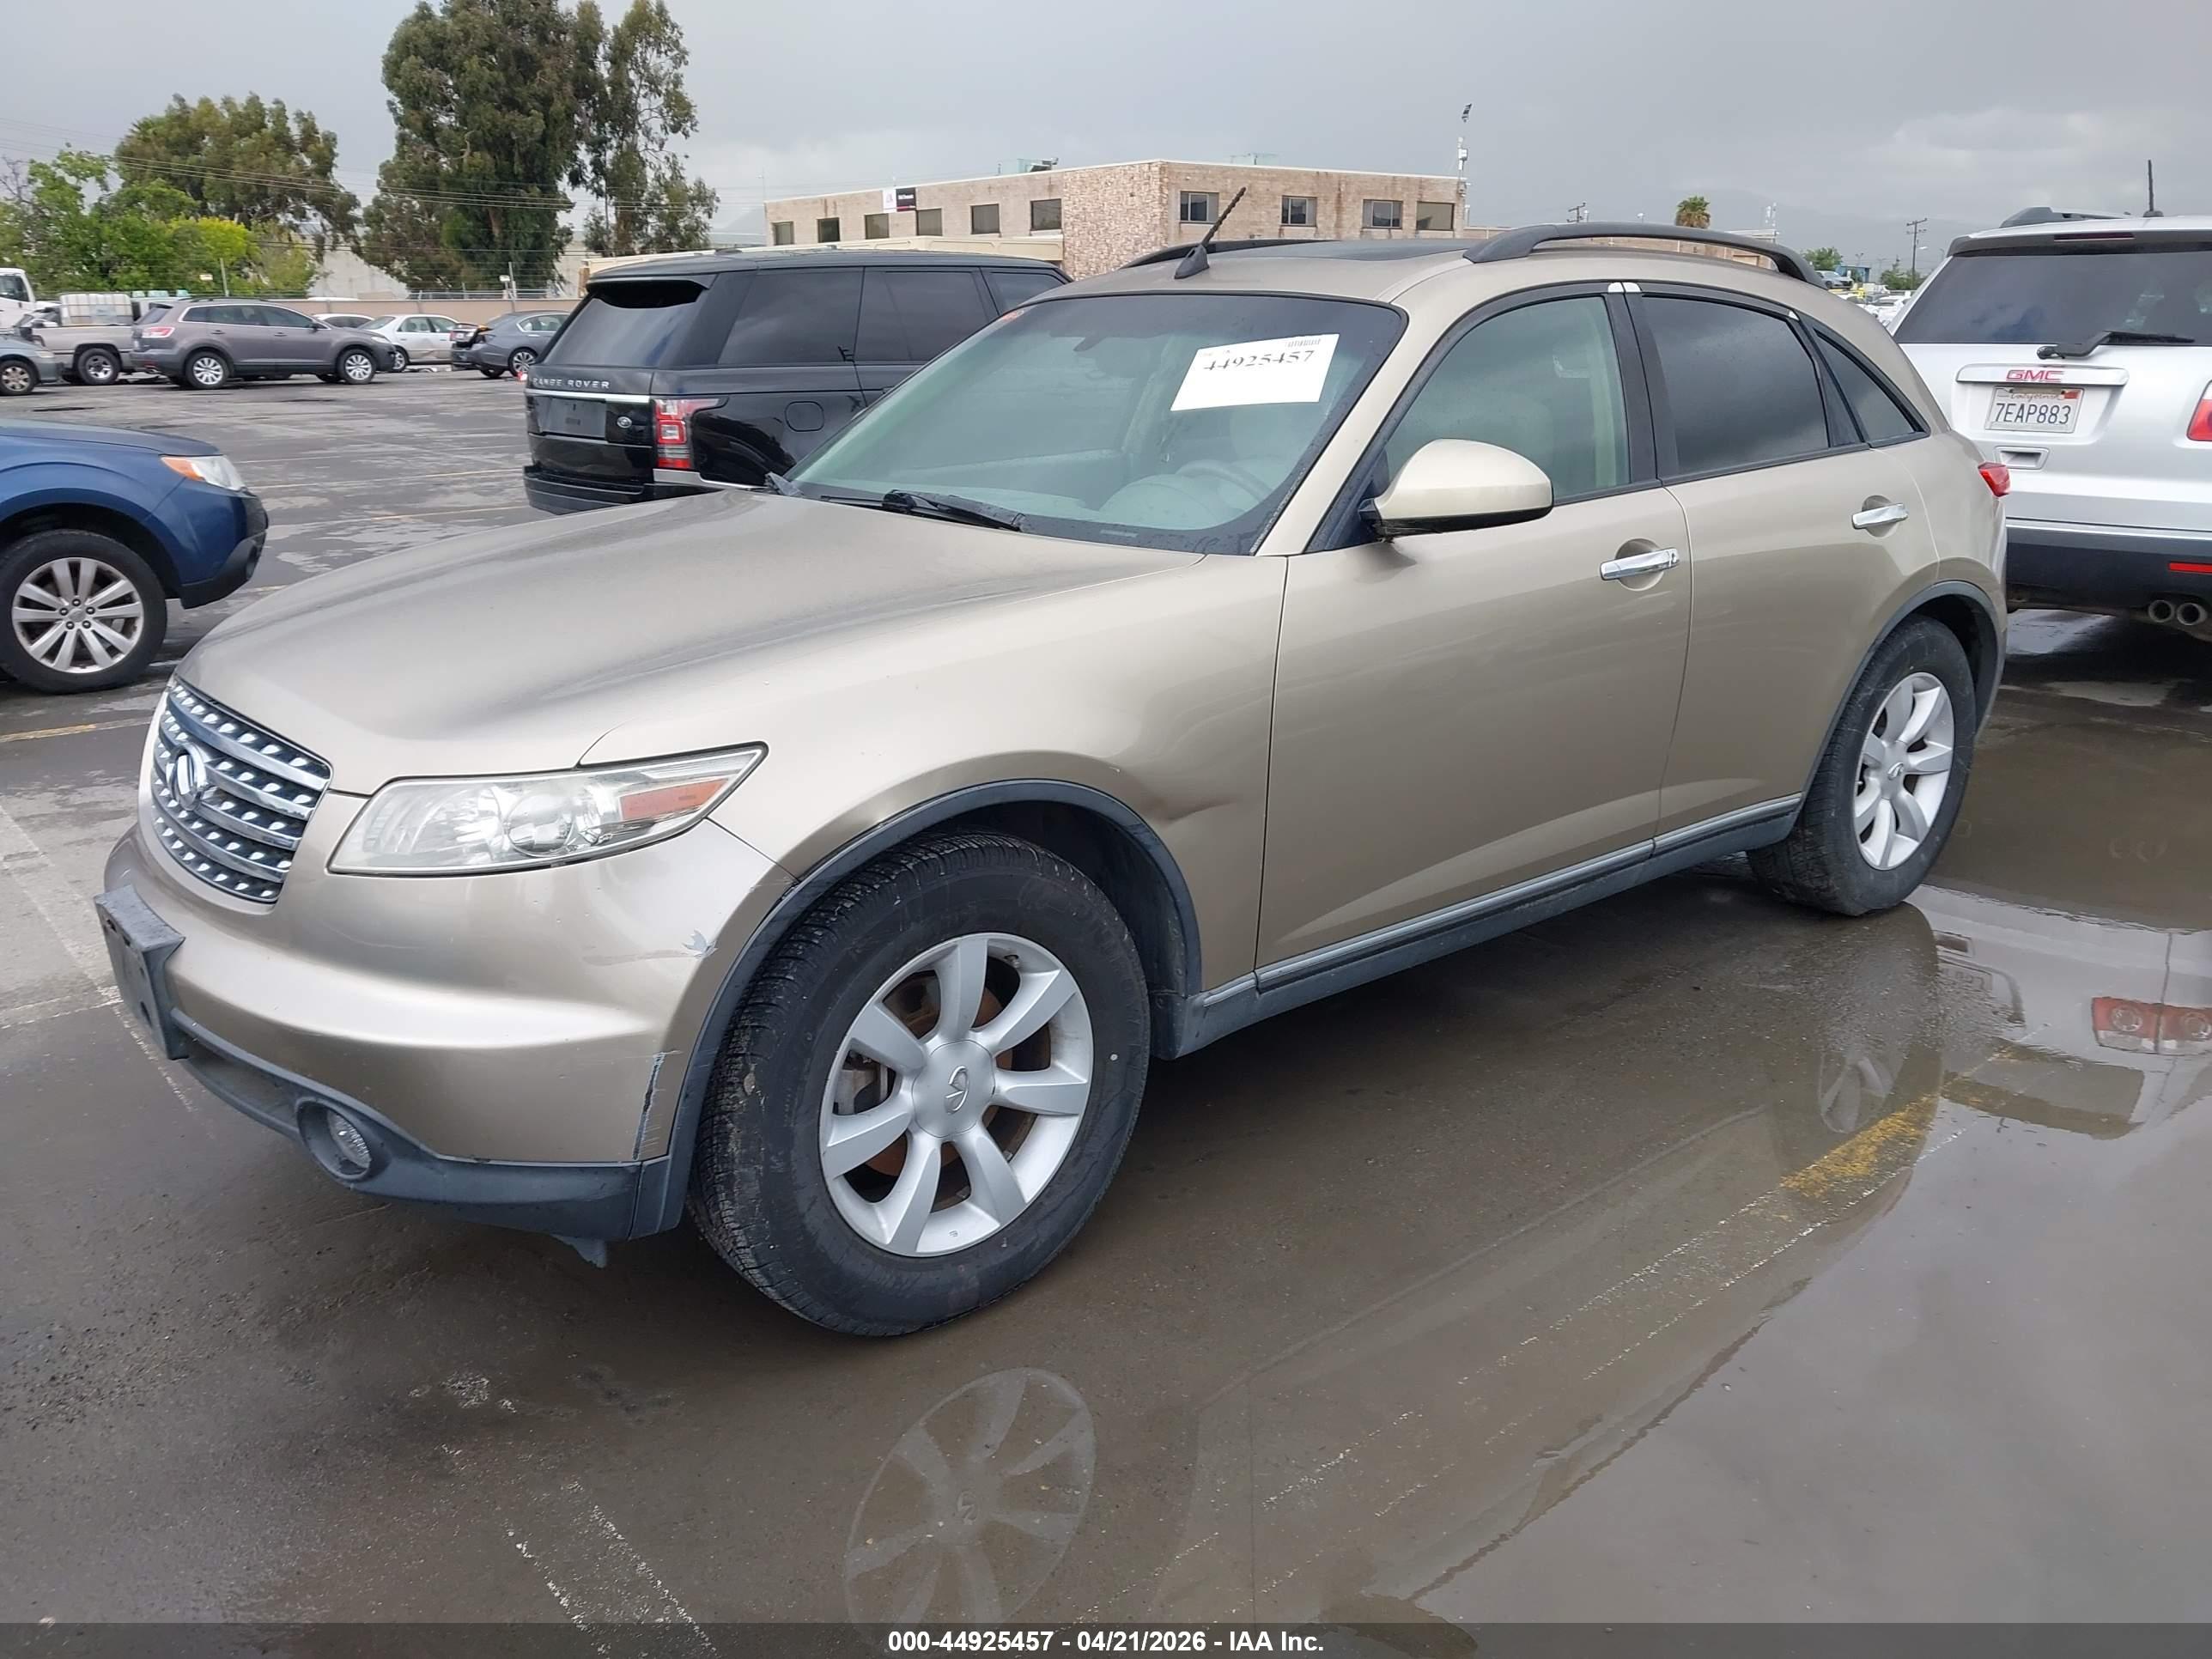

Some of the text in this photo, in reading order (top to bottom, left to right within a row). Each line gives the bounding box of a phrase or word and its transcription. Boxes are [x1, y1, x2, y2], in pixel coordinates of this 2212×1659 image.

[1204, 350, 1315, 370] 44925457
[532, 377, 610, 389] RANGE ROVER
[2005, 369, 2064, 382] GMC
[1995, 403, 2071, 423] 7EAP883
